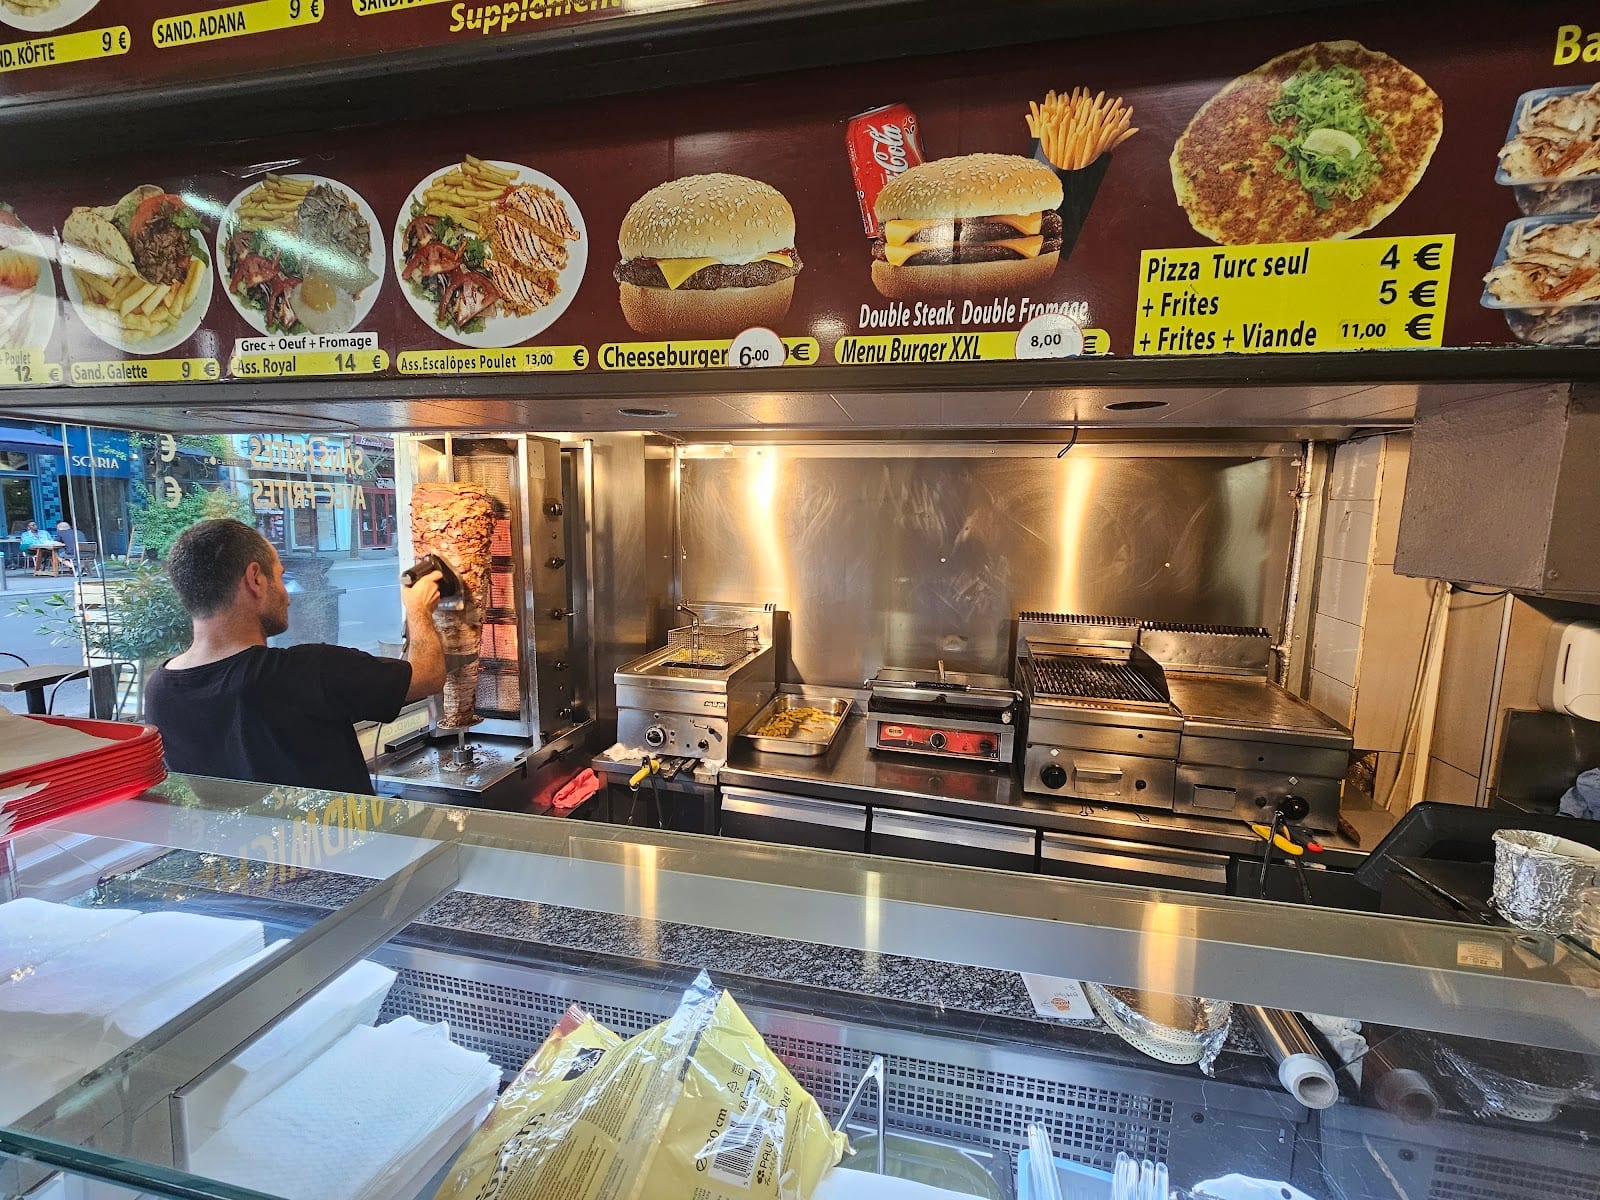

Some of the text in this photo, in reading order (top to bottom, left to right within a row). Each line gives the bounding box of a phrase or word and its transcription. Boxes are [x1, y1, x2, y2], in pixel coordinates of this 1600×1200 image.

[157, 20, 196, 44] SAND.
[199, 11, 246, 37] ADANA
[290, 0, 301, 19] 9
[18, 41, 55, 66] KÖFTE
[102, 32, 112, 51] 9
[118, 31, 127, 49] €
[1146, 243, 1443, 282] Pizza Turc seul 4 €
[858, 301, 910, 328] Double
[912, 302, 956, 327] Steak
[961, 297, 1016, 325] Double
[1160, 292, 1219, 317] Frites
[1379, 279, 1398, 305] 5
[1408, 279, 1438, 308] €
[241, 340, 266, 352] Grec
[278, 337, 306, 350] Oeuf
[319, 336, 372, 350] Fromage
[1157, 325, 1216, 352] Frites
[1242, 320, 1317, 348] Viande
[1341, 323, 1386, 340] 11,00
[1404, 313, 1434, 341] €
[480, 354, 516, 368] Poulet
[526, 354, 553, 366] 13,00
[573, 349, 585, 367] €
[603, 344, 730, 367] Cheeseburger
[790, 344, 810, 361] €
[841, 339, 886, 363] Menu
[891, 343, 947, 362] Burger
[949, 335, 981, 359] XXL
[1031, 333, 1062, 349] 8,00
[14, 365, 59, 382] 12 €
[74, 361, 216, 380] Sand. Galette 9 €
[263, 356, 296, 375] Royal
[335, 353, 356, 371] 14
[372, 355, 381, 369] €
